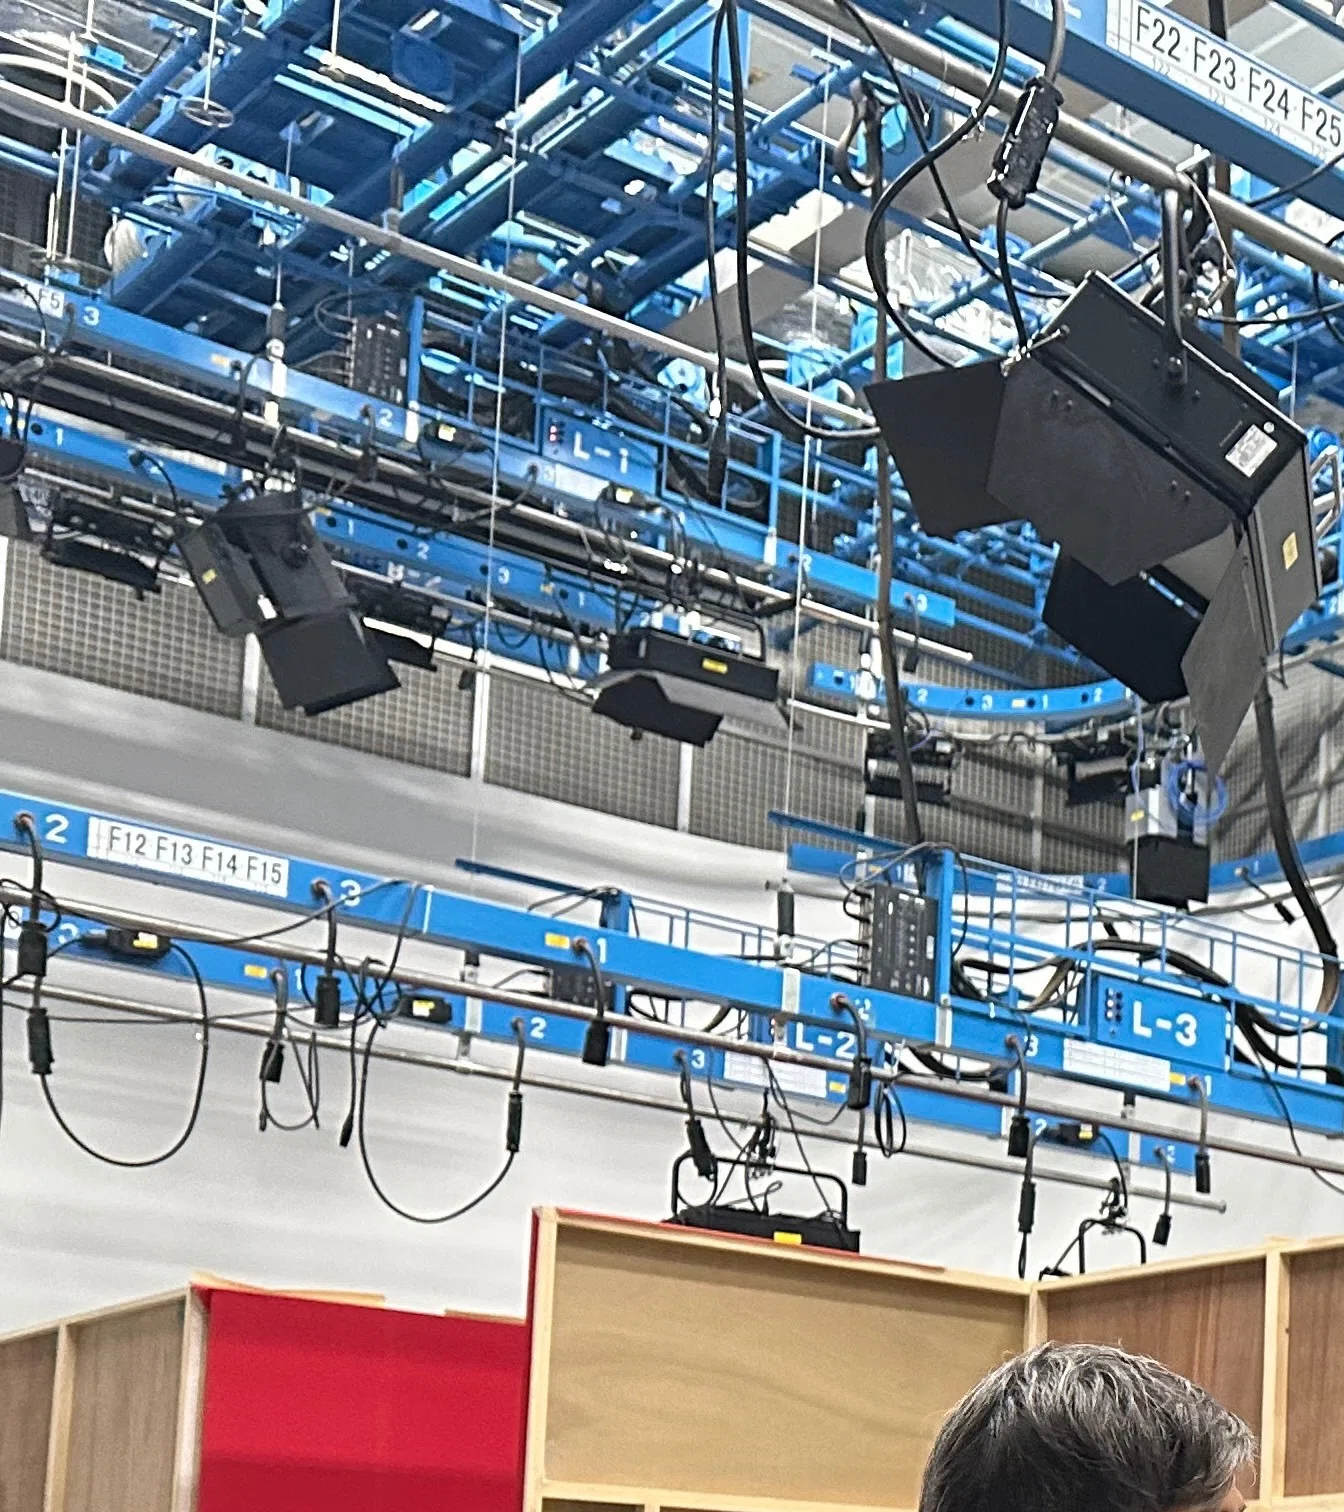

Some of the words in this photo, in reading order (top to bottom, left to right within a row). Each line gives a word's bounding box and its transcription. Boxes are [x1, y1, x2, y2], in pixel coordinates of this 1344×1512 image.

[1136, 5, 1182, 63] F22
[1194, 38, 1237, 91] F23
[1249, 66, 1290, 121] F24
[1302, 96, 1342, 148] F25
[83, 304, 100, 327] 3
[378, 408, 394, 428] 2
[573, 431, 630, 475] L-1
[44, 813, 69, 844] 2
[109, 825, 147, 856] F12
[156, 835, 193, 866] F13
[202, 846, 238, 875] F14
[247, 855, 283, 885] F15
[340, 880, 362, 907] 3
[596, 937, 606, 964] 1
[530, 1017, 547, 1039] 2
[1132, 1000, 1198, 1047] L-3
[795, 1021, 857, 1059] L-2
[691, 1049, 705, 1070] 3
